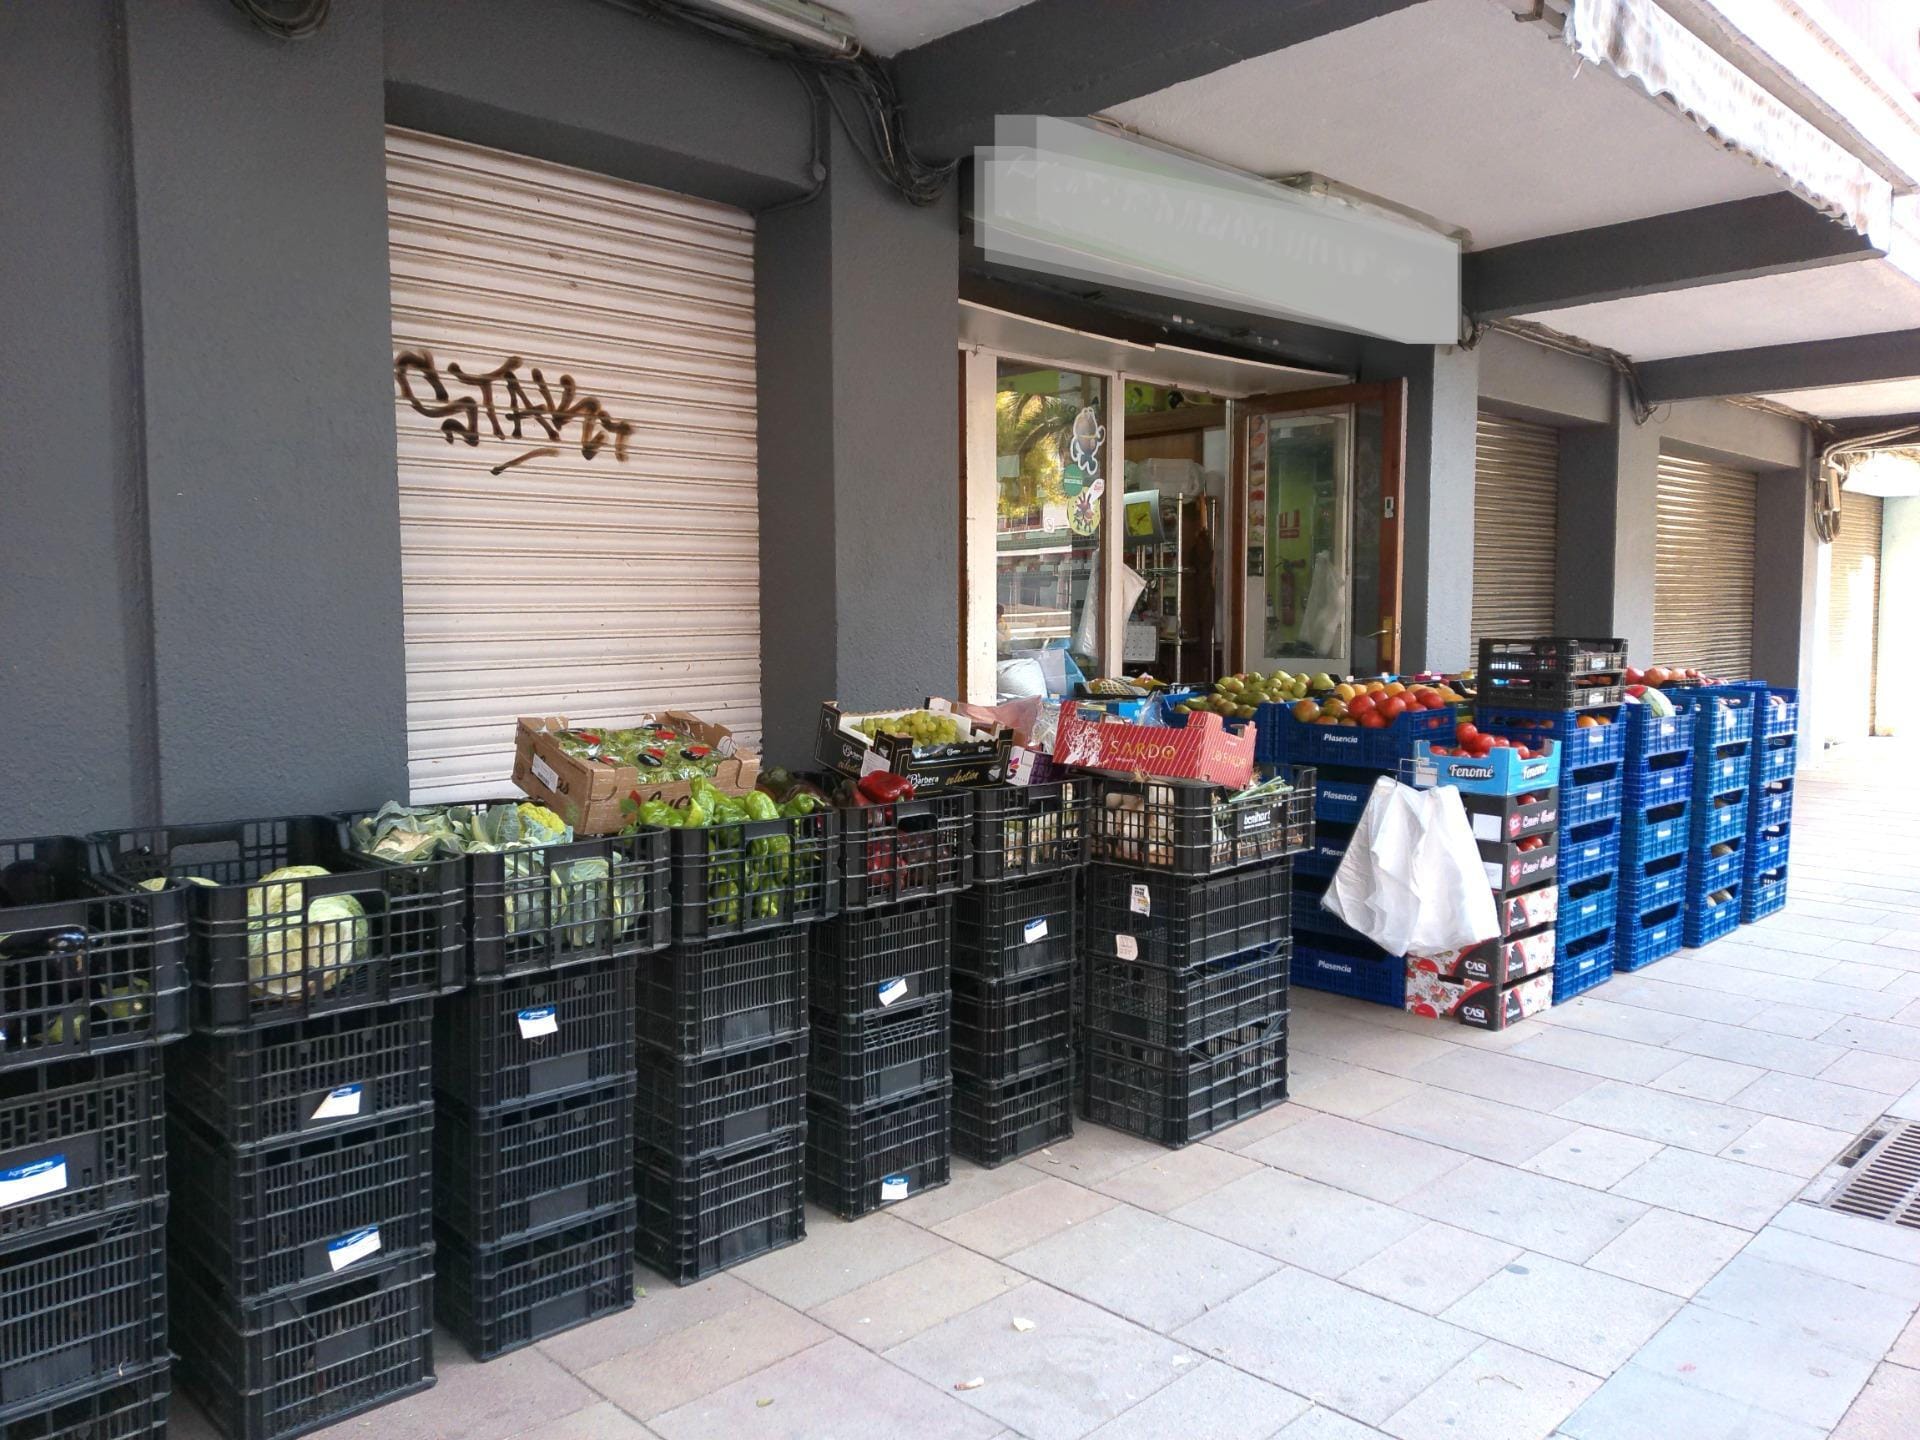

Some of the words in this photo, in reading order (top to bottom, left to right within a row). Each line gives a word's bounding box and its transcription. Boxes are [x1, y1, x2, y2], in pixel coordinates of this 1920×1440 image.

[1324, 733, 1358, 743] Plasencia
[1110, 740, 1176, 760] SARDO
[1449, 763, 1494, 778] Fenomé
[1323, 790, 1357, 801] Plasencia
[1318, 960, 1352, 973] Plasencia
[1464, 960, 1487, 972] CASI
[1463, 1006, 1485, 1019] CASI
